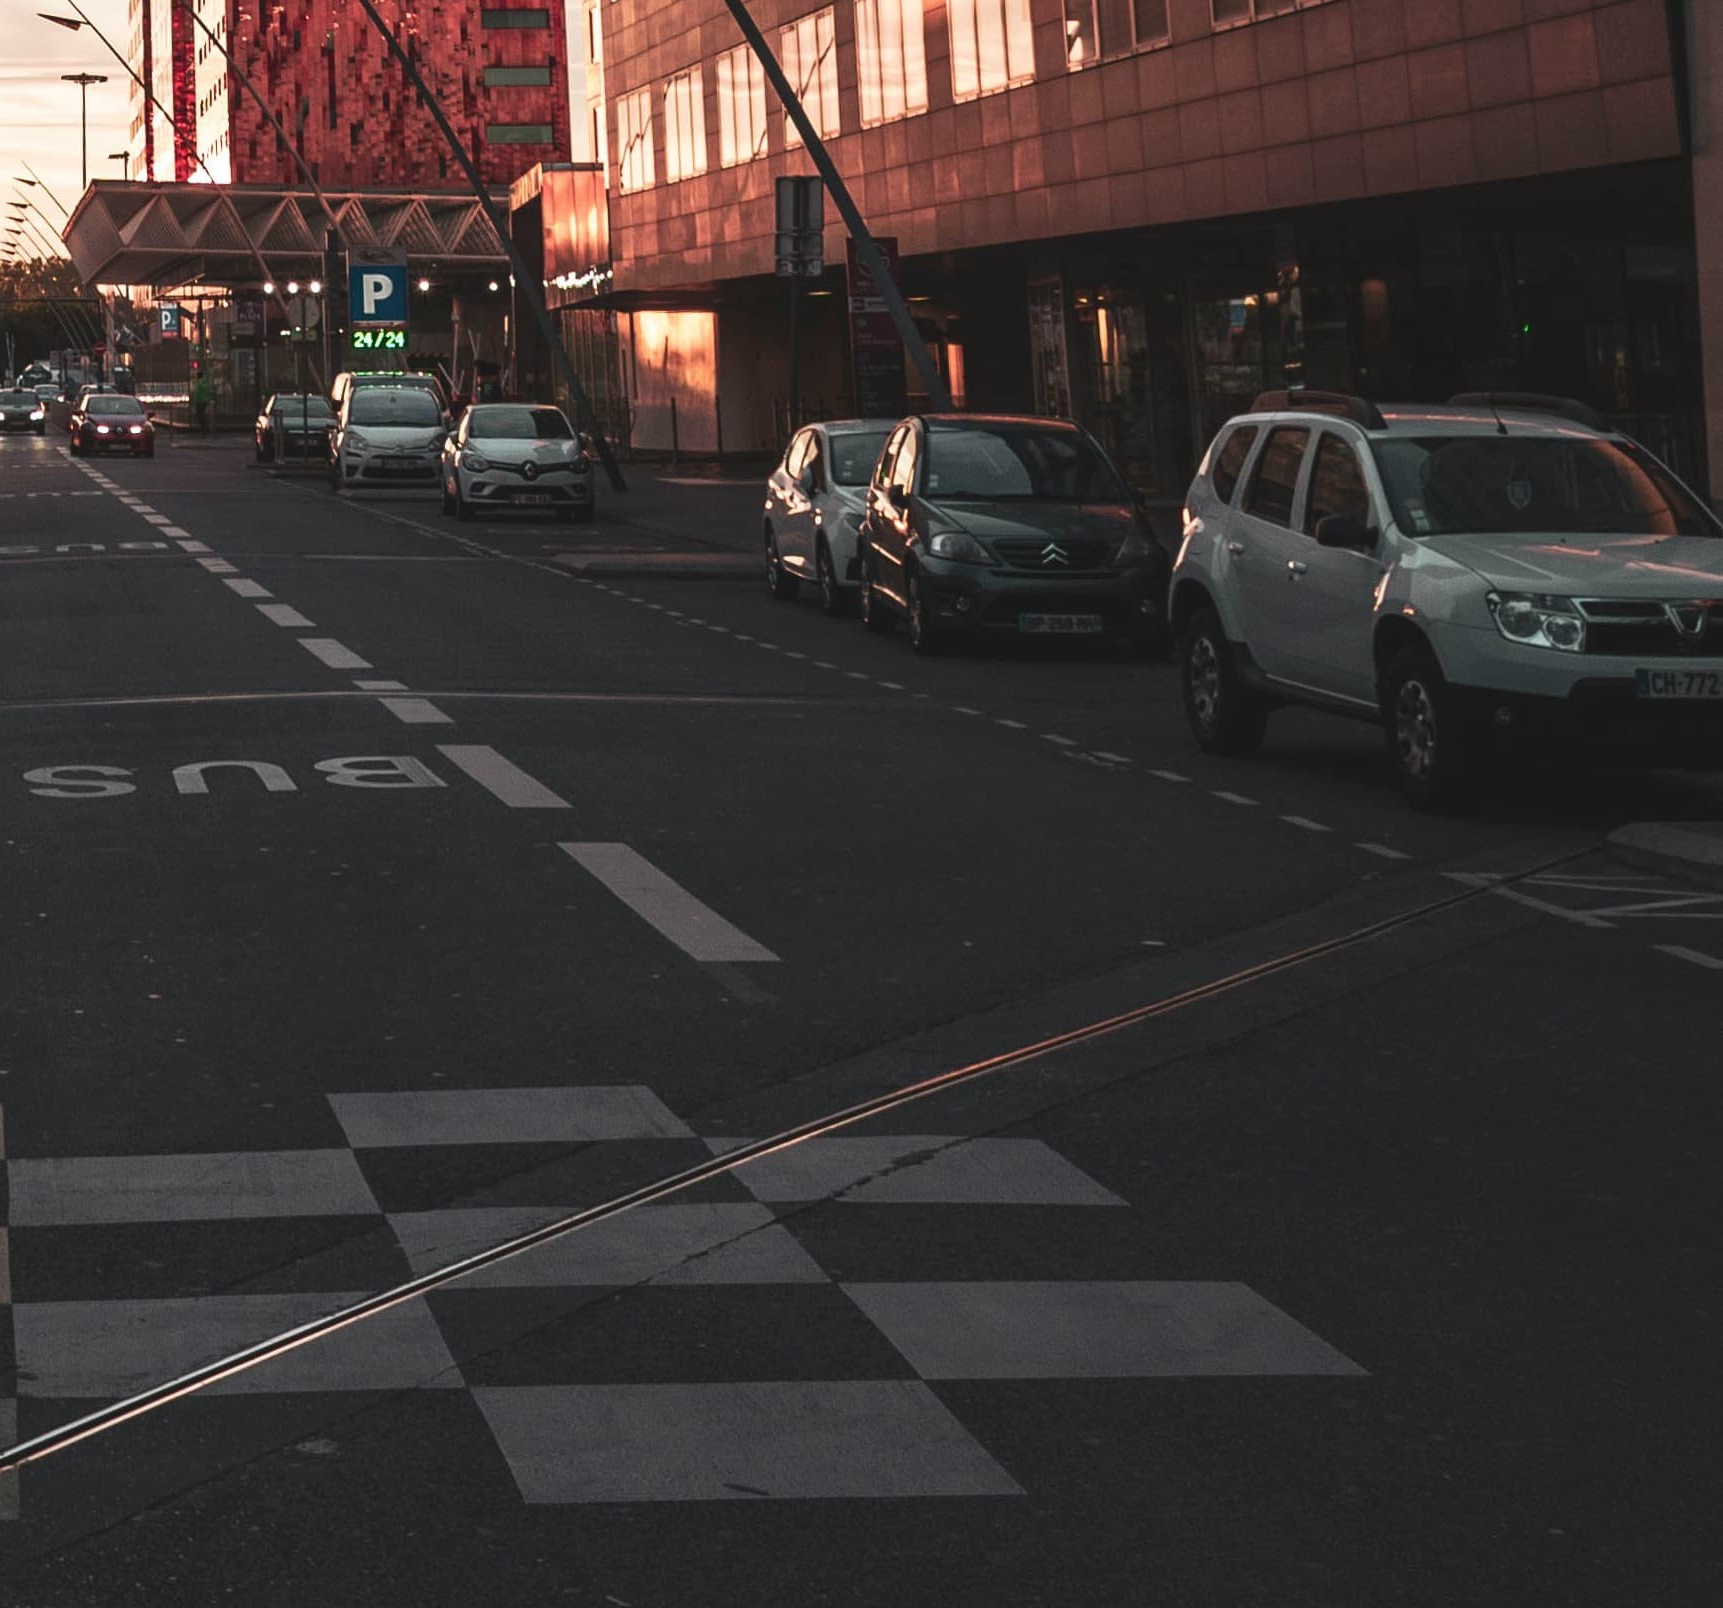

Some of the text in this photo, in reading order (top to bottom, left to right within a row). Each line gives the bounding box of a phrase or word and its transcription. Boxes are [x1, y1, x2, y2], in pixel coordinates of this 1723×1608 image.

[362, 273, 394, 315] P
[353, 329, 405, 348] 24/24
[23, 754, 450, 798] BUS
